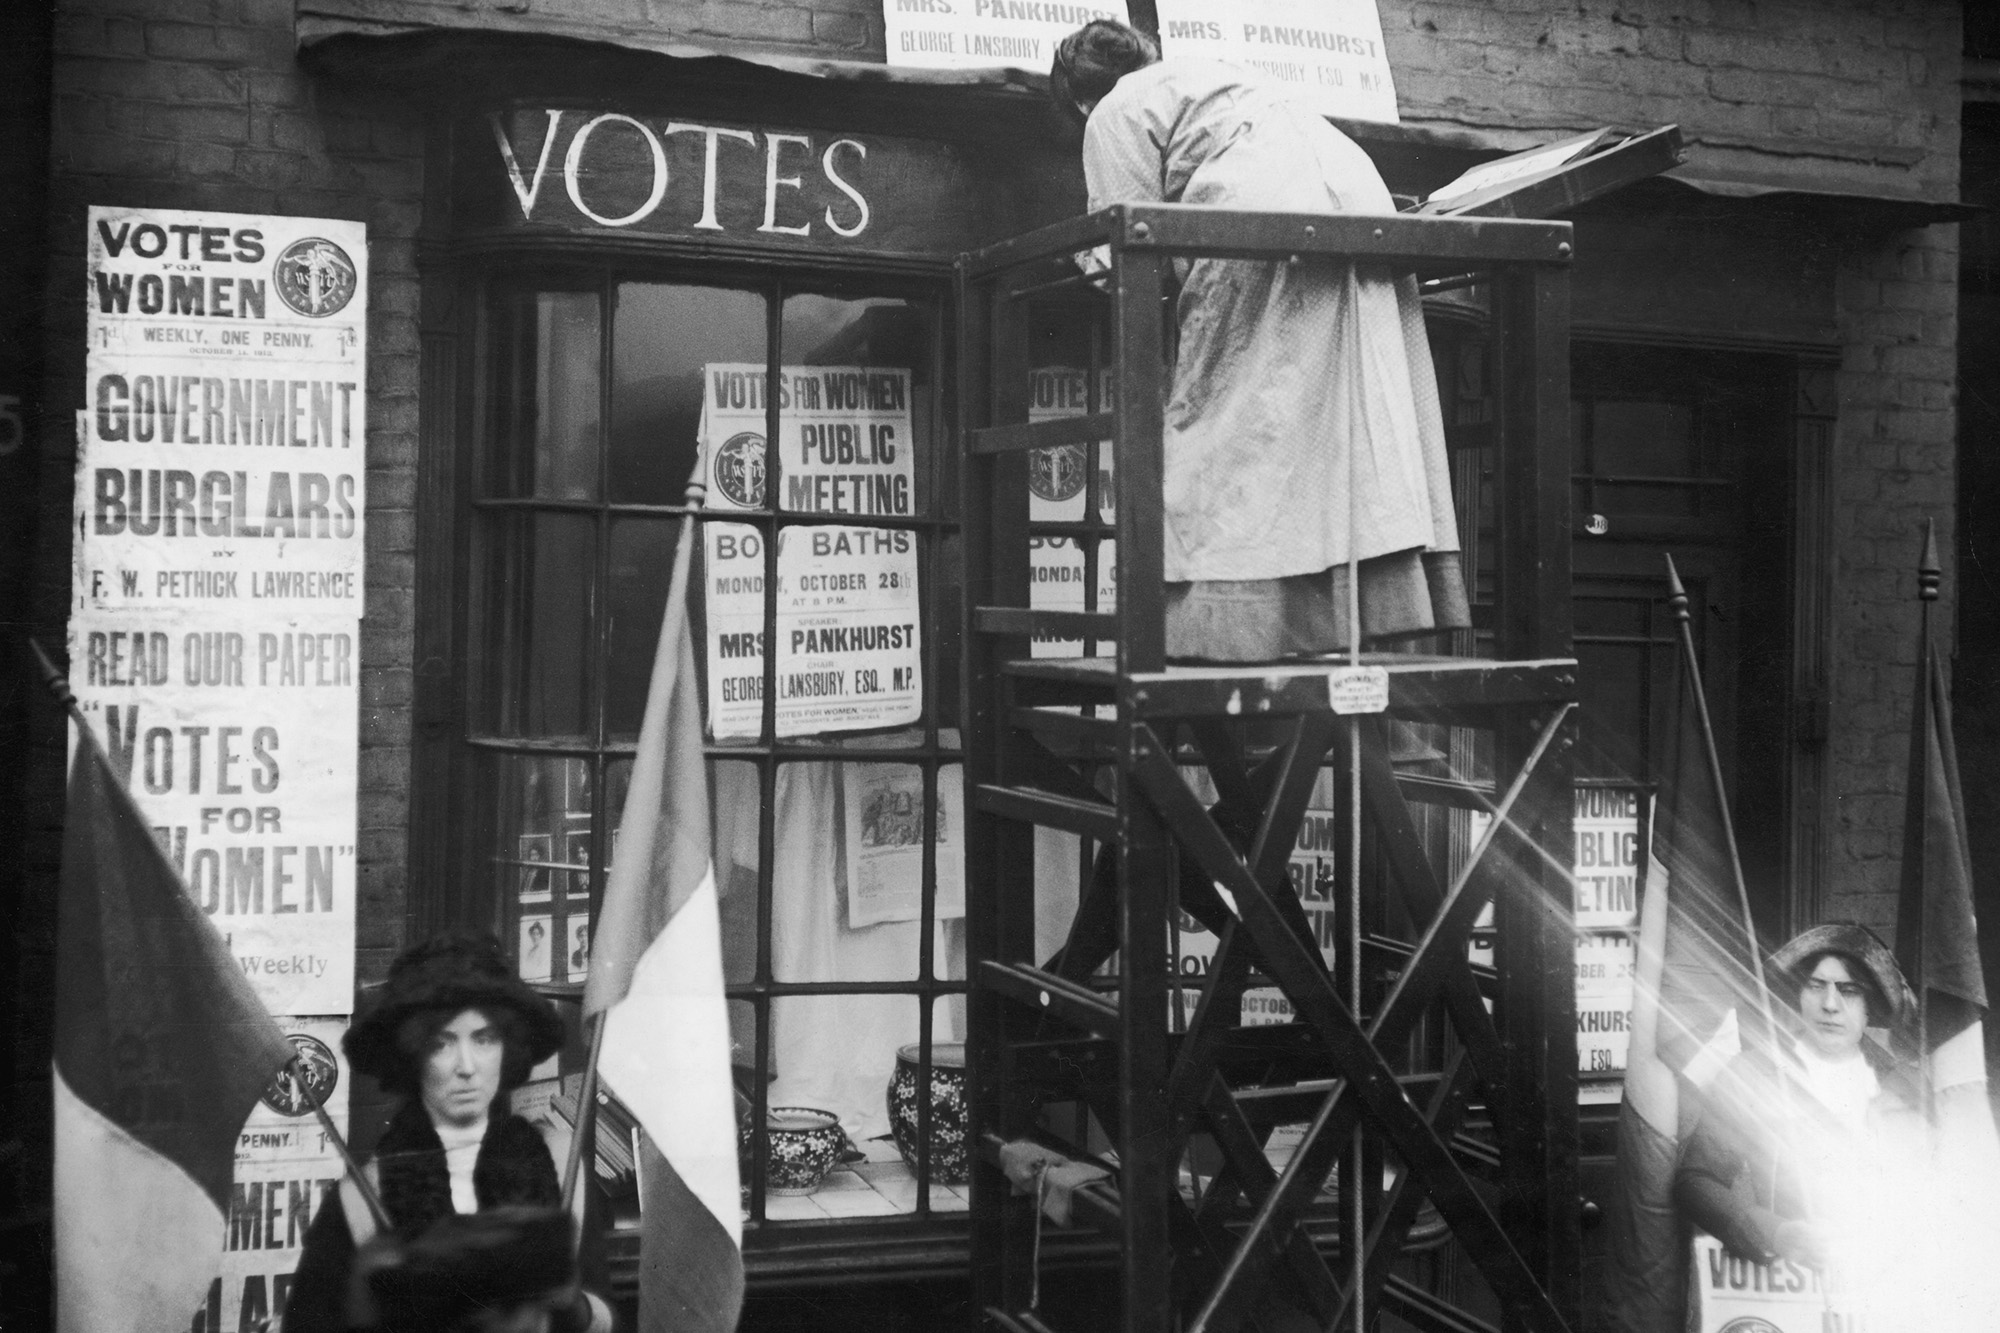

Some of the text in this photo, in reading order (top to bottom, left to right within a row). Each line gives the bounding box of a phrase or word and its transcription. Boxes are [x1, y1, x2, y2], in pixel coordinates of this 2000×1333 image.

[900, 30, 956, 54] GEORGE
[1167, 20, 1377, 58] MRS. PANKHURST
[492, 109, 870, 238] VOTES
[96, 218, 265, 264] VOTES
[161, 262, 202, 272] FOR
[95, 272, 266, 319] WOMEN
[221, 329, 251, 346] ONE
[262, 332, 315, 348] PENNY.
[793, 376, 821, 411] FOR
[823, 373, 906, 411] WOMEN
[96, 374, 357, 449] GOVERNMENT
[800, 424, 896, 466] PUBLIC
[94, 468, 355, 539] BURGLARS
[787, 474, 909, 515] MEETING
[212, 550, 236, 558] BY
[812, 529, 910, 557] BATHS
[121, 570, 144, 598] W.
[156, 571, 238, 599] PETHICK
[251, 571, 355, 599] LAWRENCE
[800, 573, 867, 592] OCTOBER
[792, 598, 805, 607] AT
[812, 598, 821, 607] 8
[791, 624, 915, 655] PANKHURST
[87, 631, 352, 687] READ OUR PAPER
[780, 670, 849, 699] LANSBURY,
[893, 666, 915, 692] M.P.
[200, 805, 283, 835] FOR
[239, 954, 328, 978] Weekly
